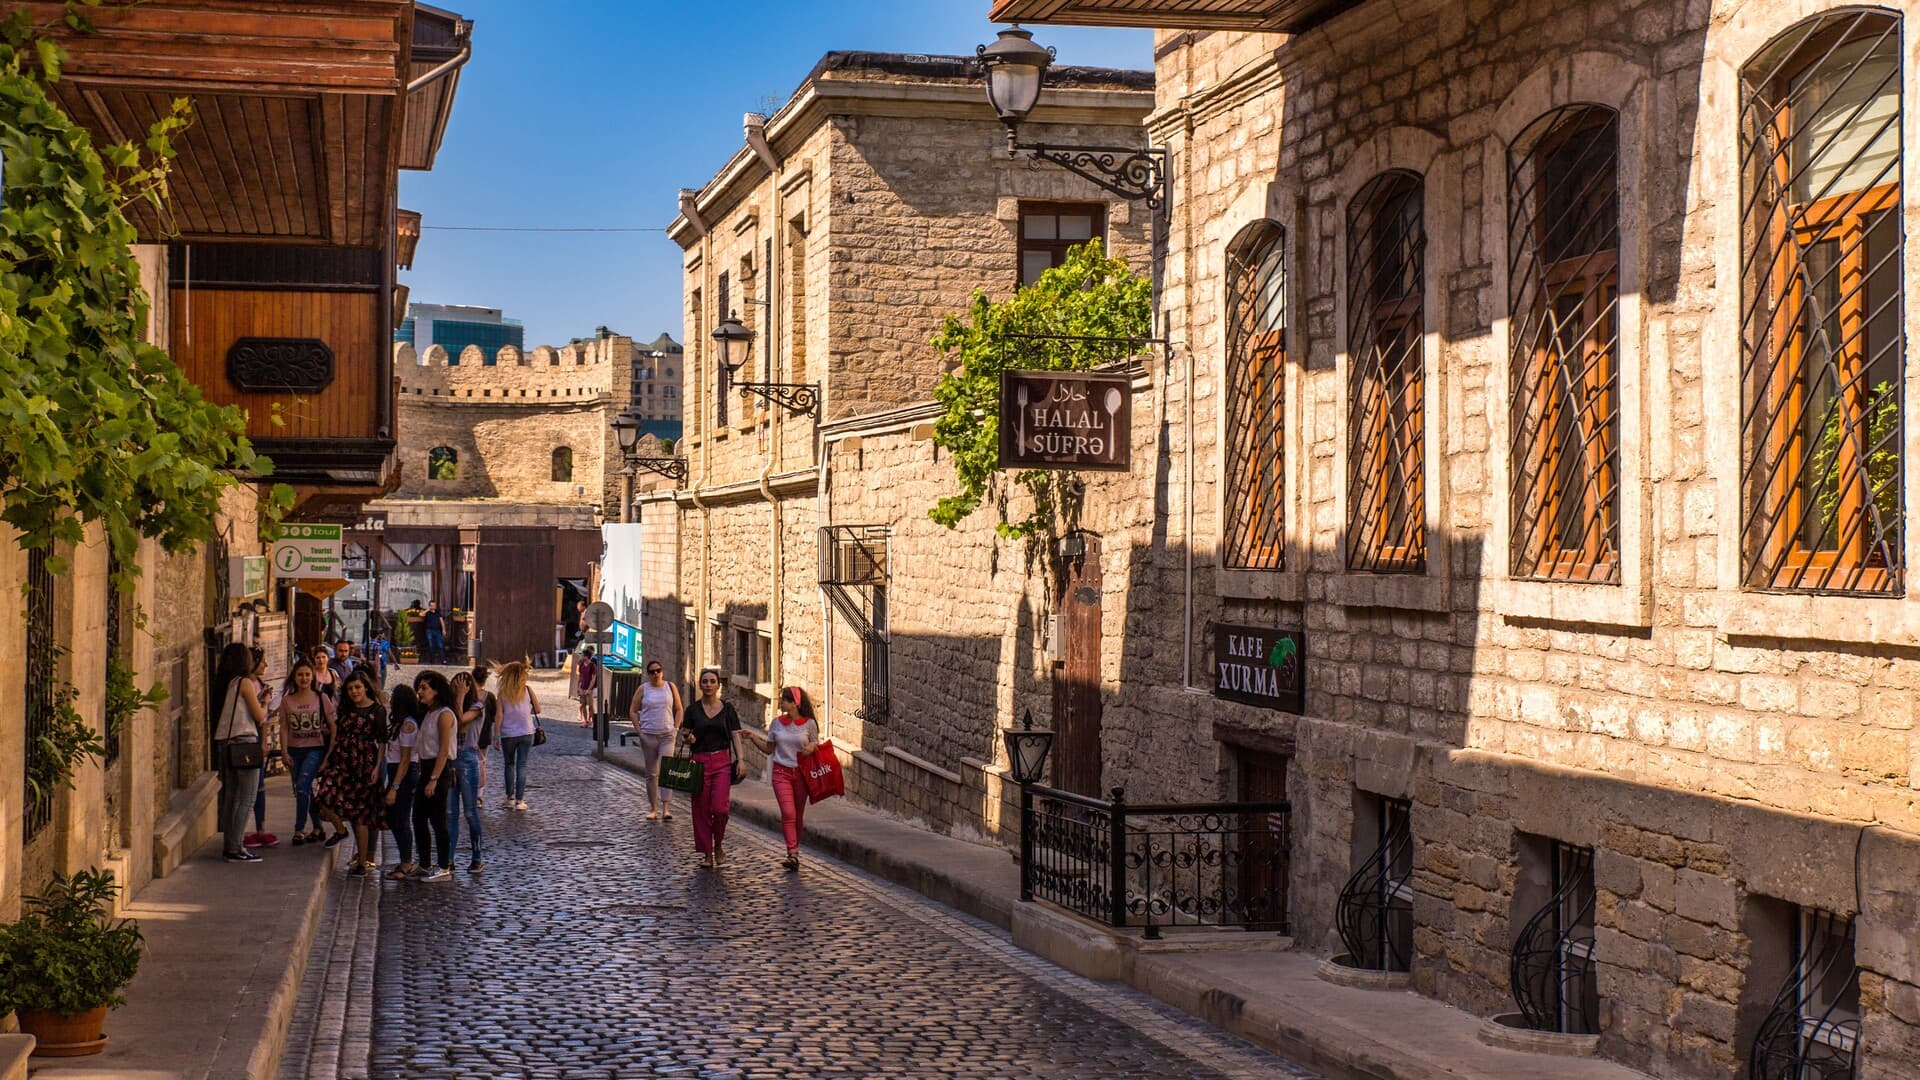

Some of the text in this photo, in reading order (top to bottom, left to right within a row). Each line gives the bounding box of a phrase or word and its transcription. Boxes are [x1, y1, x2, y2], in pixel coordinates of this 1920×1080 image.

[1033, 408, 1104, 429] HALAL
[1033, 432, 1104, 456] SÜFRƏ
[1228, 634, 1263, 659] KAFE
[1218, 662, 1280, 698] XURMA
[810, 764, 833, 779] batik
